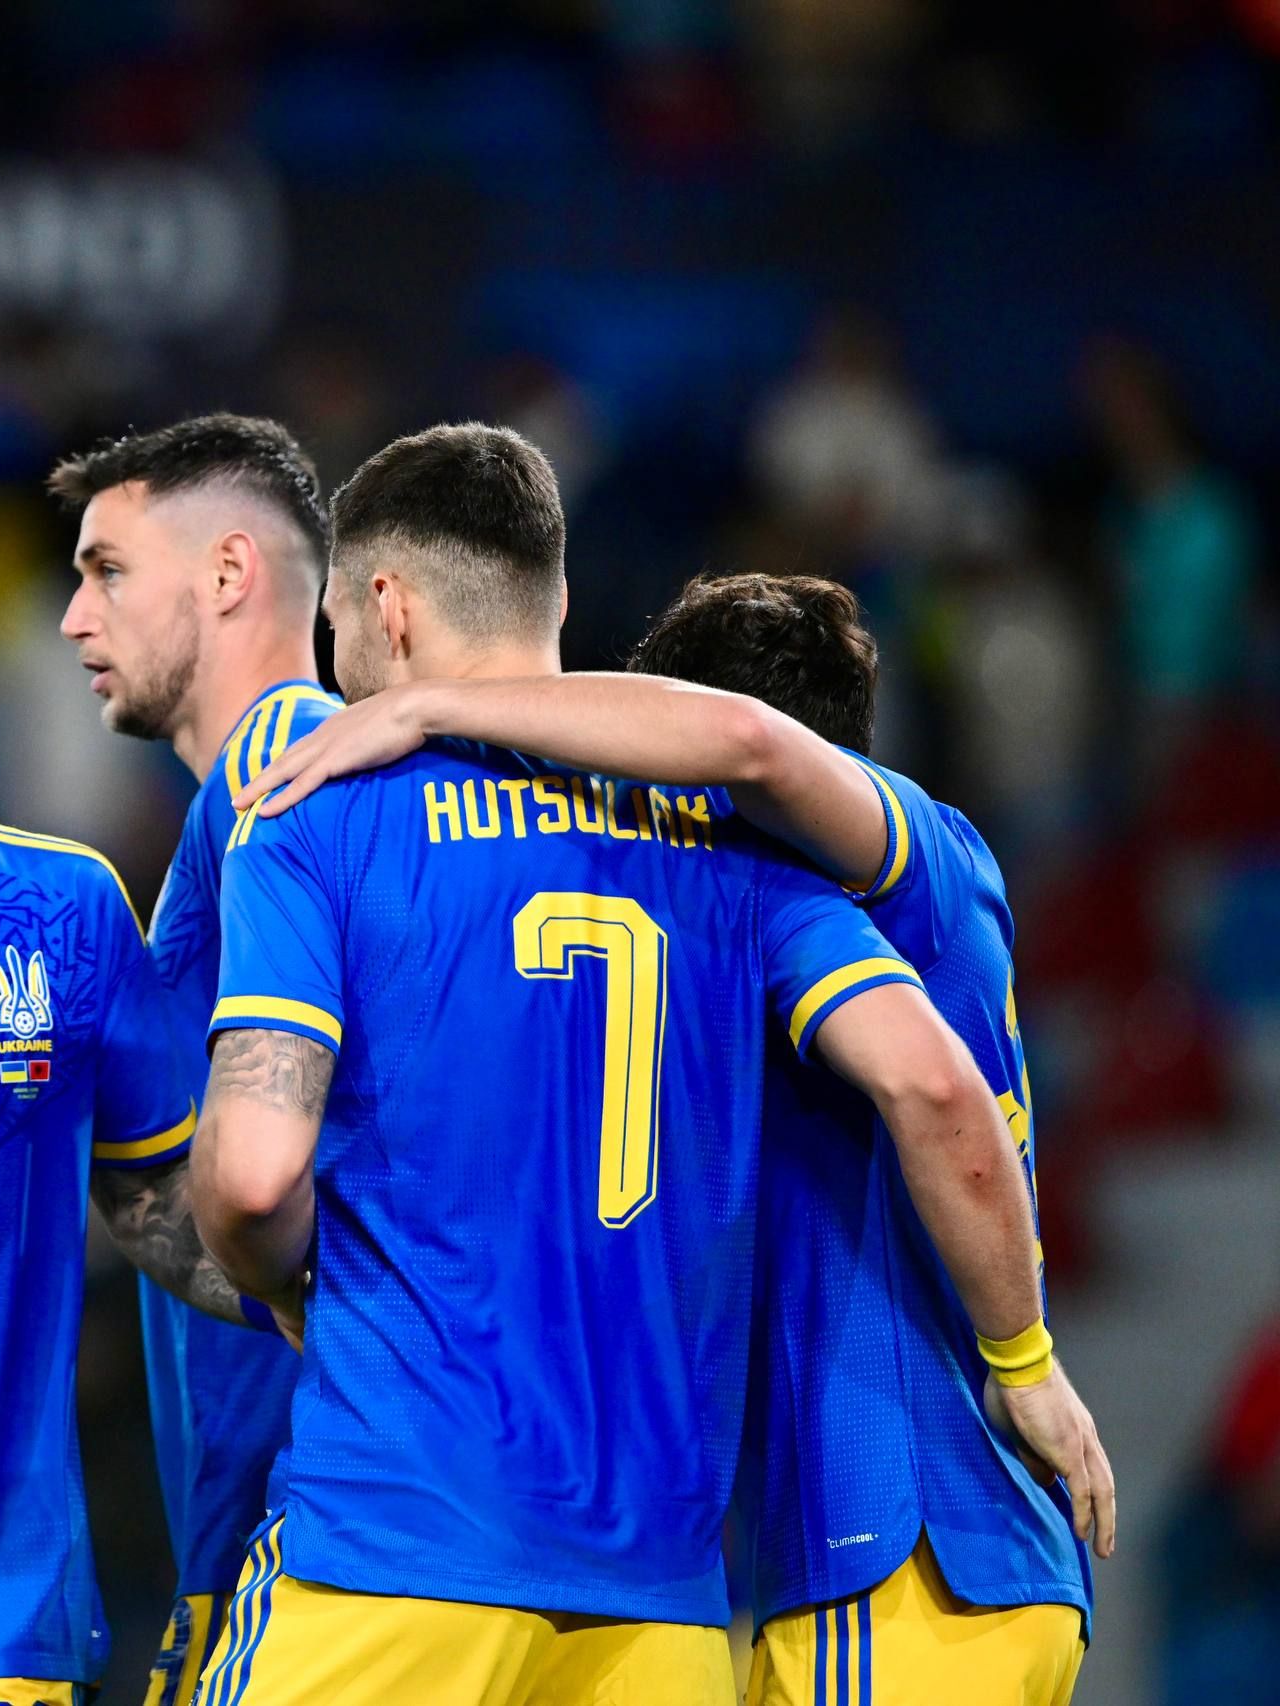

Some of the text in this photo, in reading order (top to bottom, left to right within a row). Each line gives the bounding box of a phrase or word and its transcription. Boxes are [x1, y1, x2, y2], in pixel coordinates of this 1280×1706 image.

[423, 774, 713, 852] HUTSULIAK
[513, 891, 668, 1229] 7
[829, 1532, 874, 1549] CLIMACOOL
